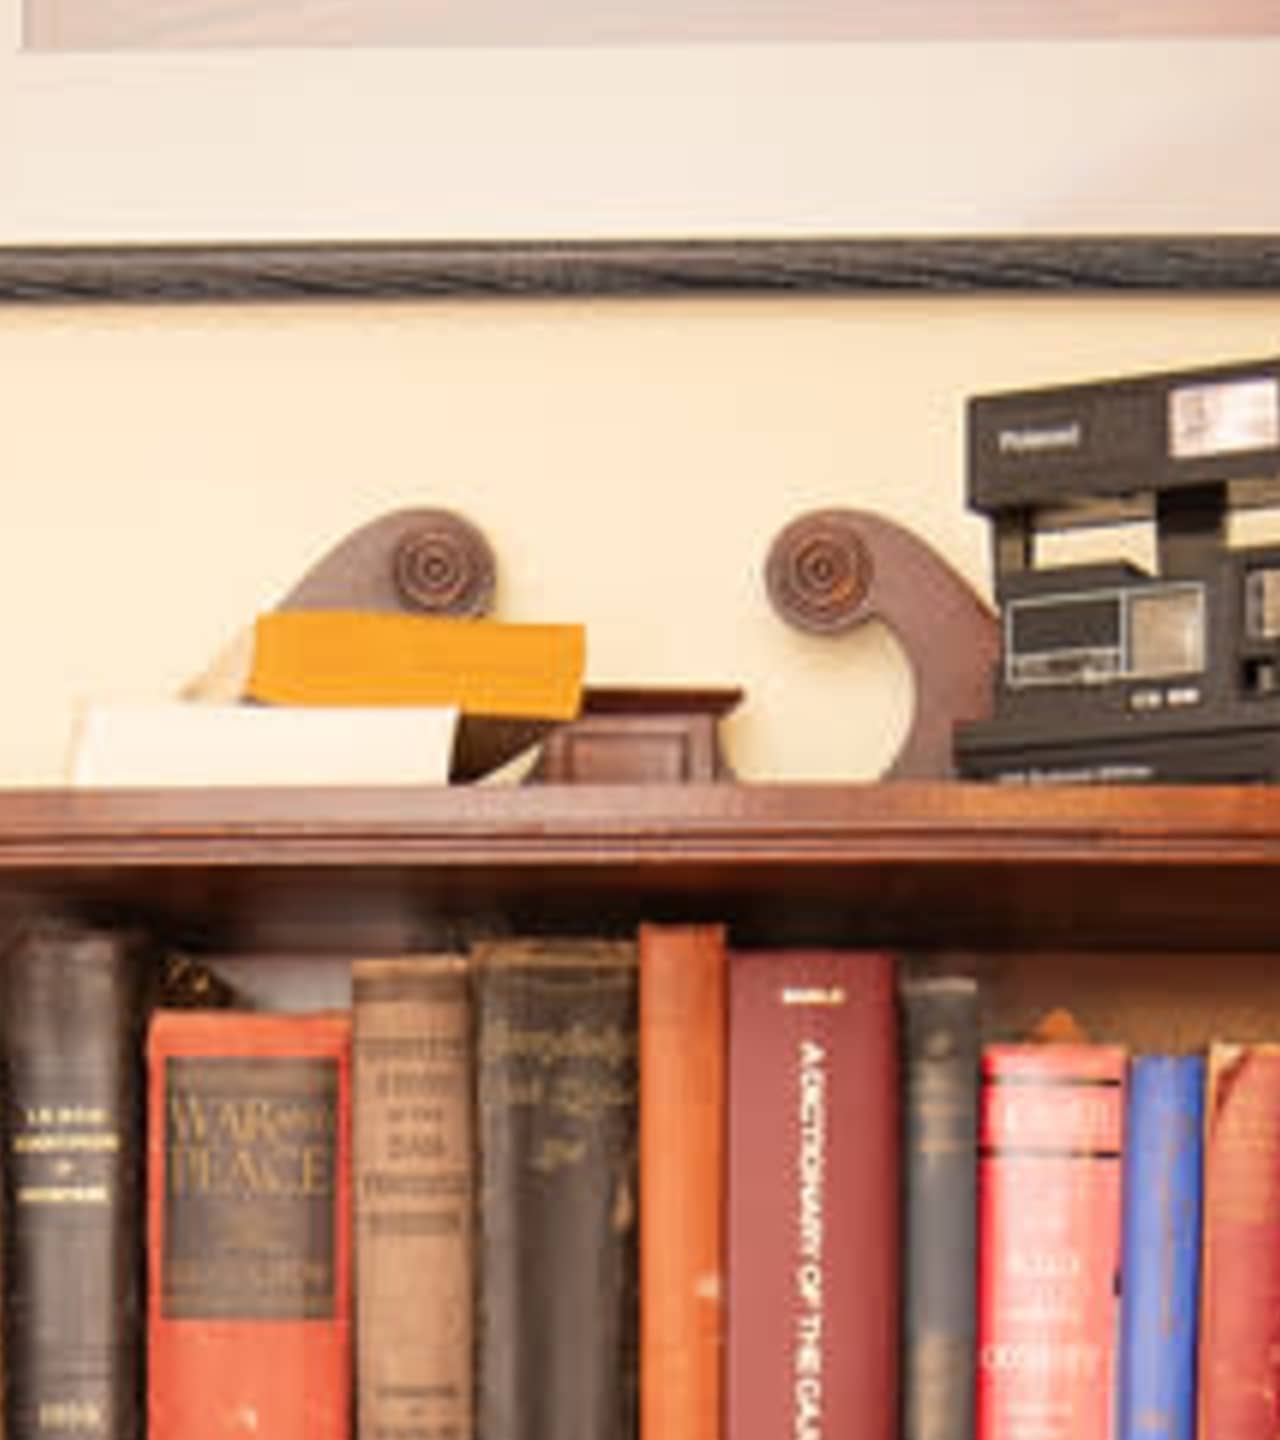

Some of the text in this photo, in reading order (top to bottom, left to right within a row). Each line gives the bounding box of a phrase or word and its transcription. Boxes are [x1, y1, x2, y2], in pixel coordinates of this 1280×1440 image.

[799, 1041, 826, 1063] A
[171, 1094, 276, 1146] WAR
[171, 1145, 328, 1198] PEACE
[800, 1068, 825, 1258] DICTIONARY
[796, 1264, 823, 1308] OF
[795, 1313, 823, 1375] THE
